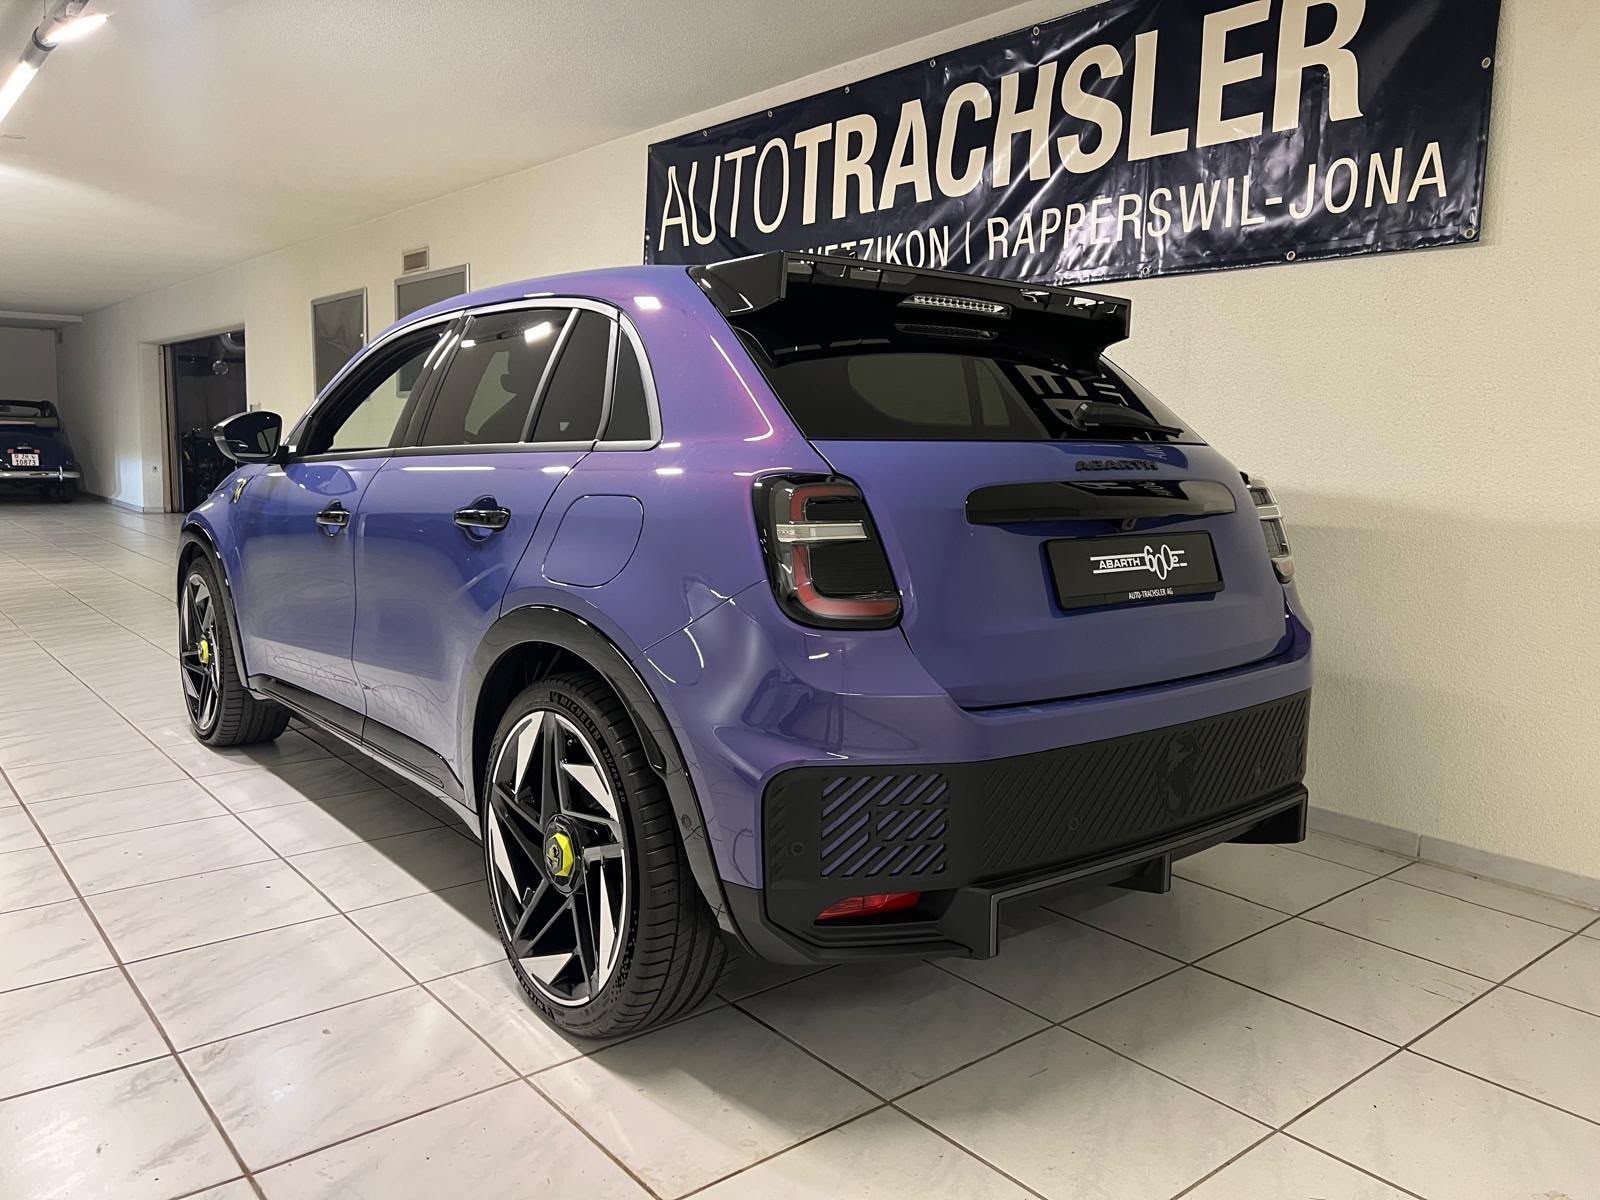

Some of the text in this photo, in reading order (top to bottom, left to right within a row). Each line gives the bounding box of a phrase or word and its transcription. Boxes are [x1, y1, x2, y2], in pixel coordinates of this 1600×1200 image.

[657, 0, 1366, 252] AUTOTRACHSLER
[800, 226, 949, 268] ZIKON
[987, 141, 1448, 261] RAPPERSWIL-JONA
[1075, 460, 1158, 471] ABARTH
[1099, 557, 1141, 570] ABARTH
[1128, 587, 1174, 600] AUTO-TRACHSLER AG
[559, 695, 601, 740] MICHELIN
